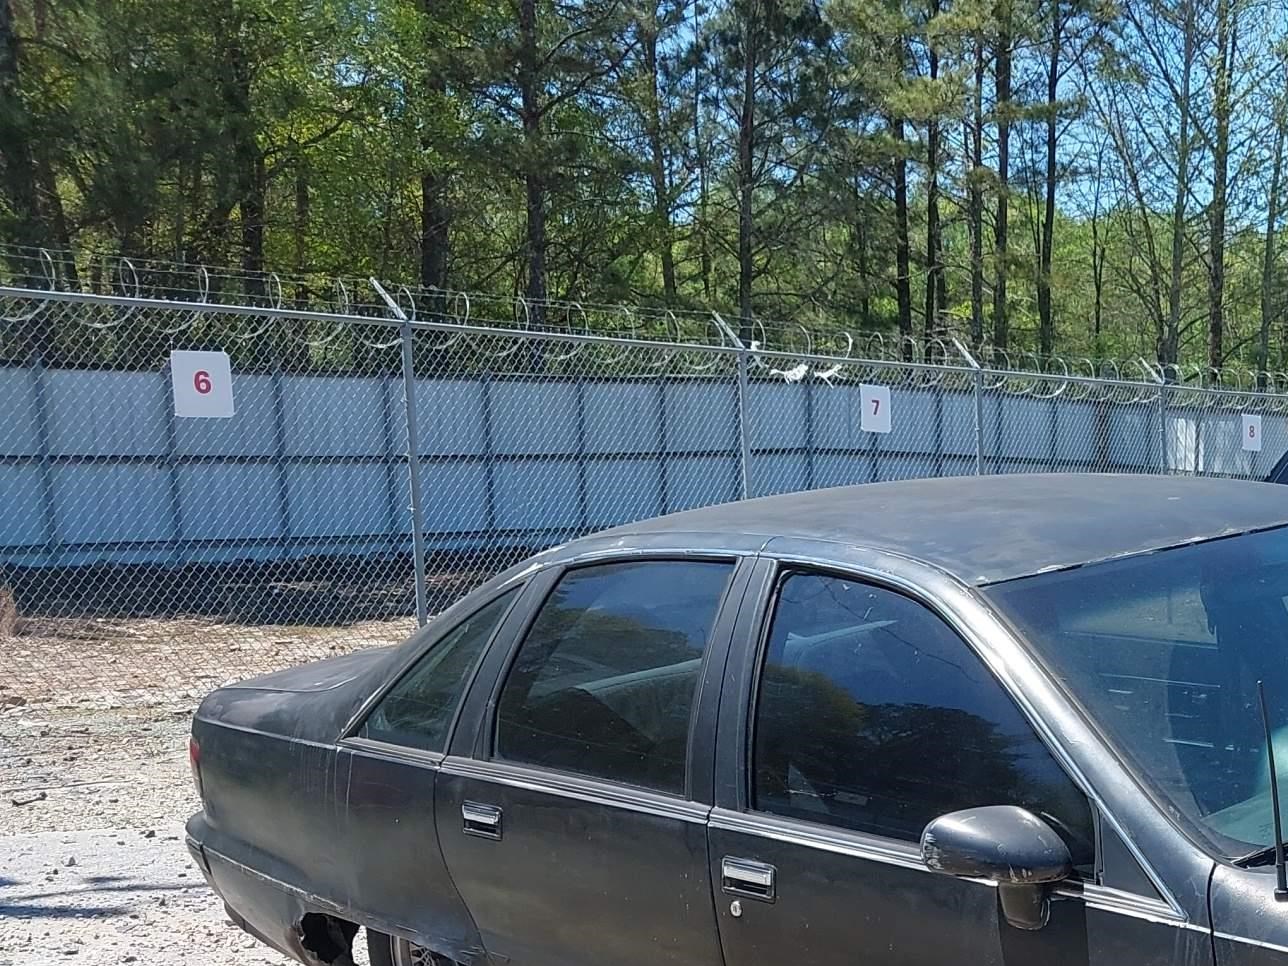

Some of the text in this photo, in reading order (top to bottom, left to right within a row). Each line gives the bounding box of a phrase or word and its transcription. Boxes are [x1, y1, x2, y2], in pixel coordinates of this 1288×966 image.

[194, 371, 211, 394] 6
[872, 400, 879, 415] 7
[1249, 425, 1255, 438] 8
